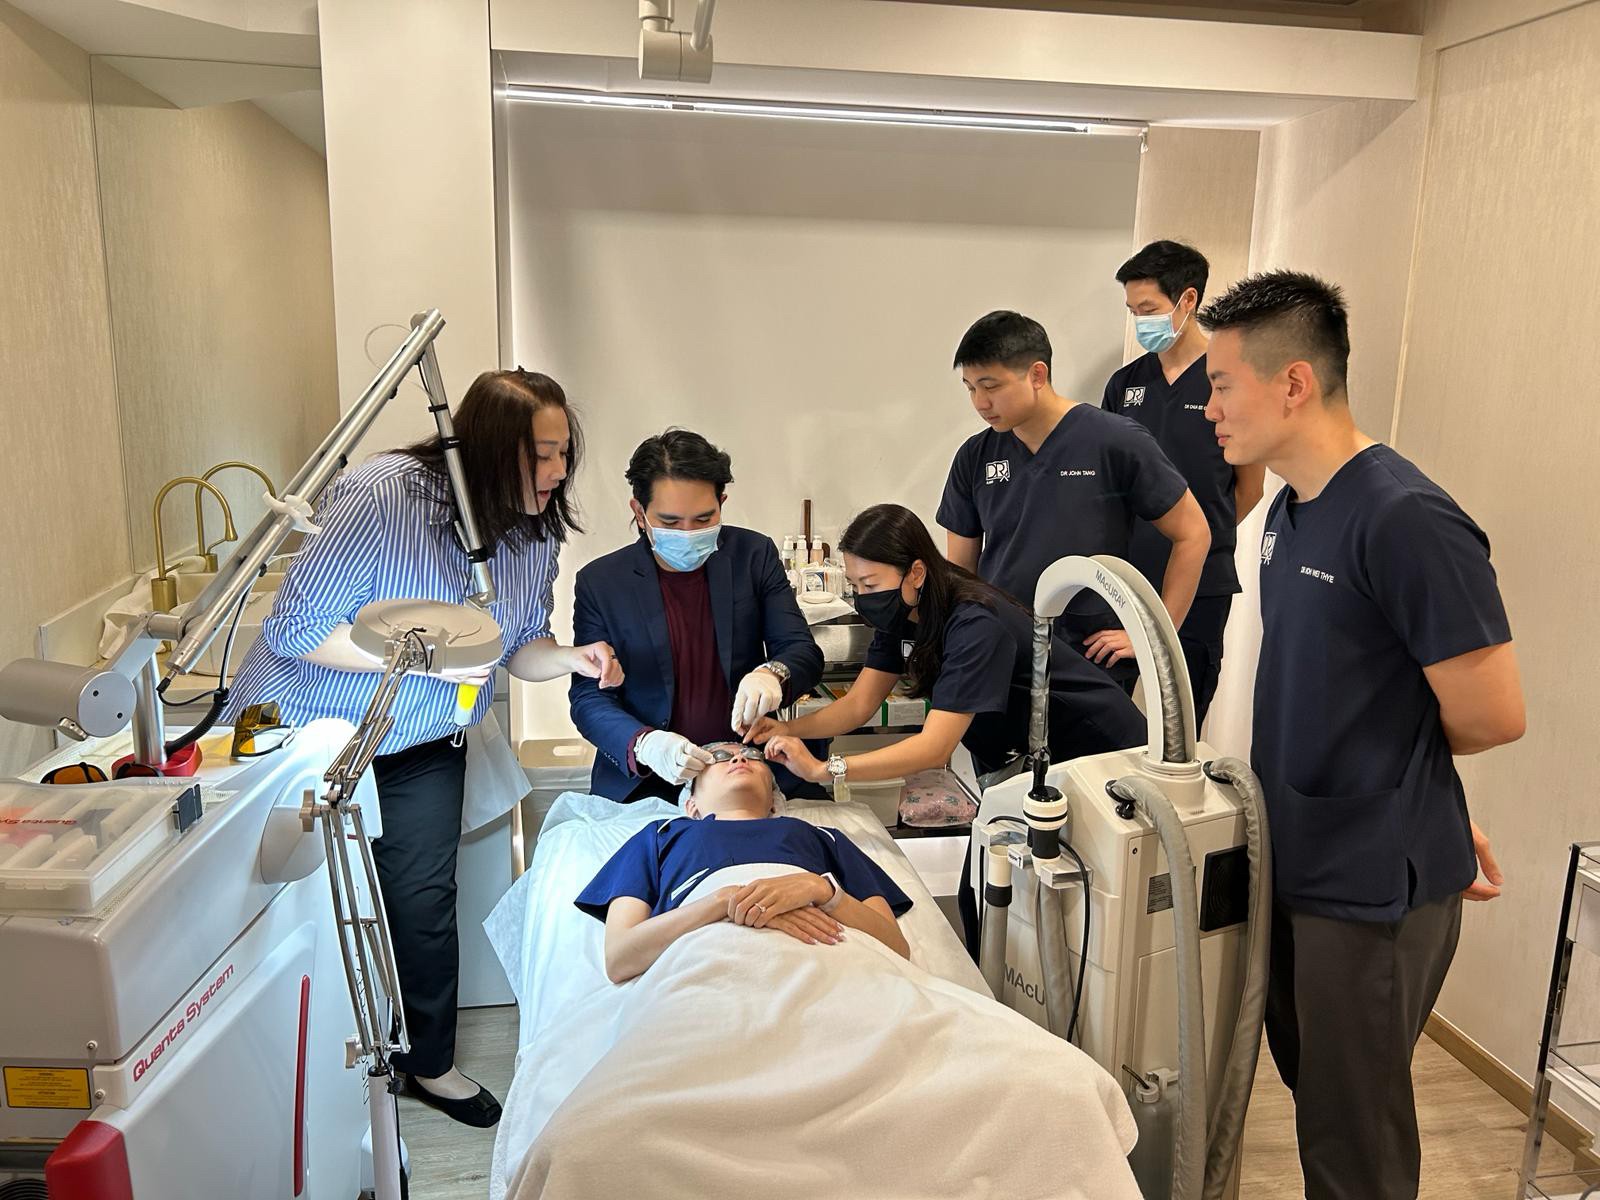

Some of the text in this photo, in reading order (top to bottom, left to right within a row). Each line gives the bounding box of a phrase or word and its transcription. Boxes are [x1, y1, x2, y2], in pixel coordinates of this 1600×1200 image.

[1320, 571, 1335, 583] THYE
[133, 964, 234, 1082] Quanta System
